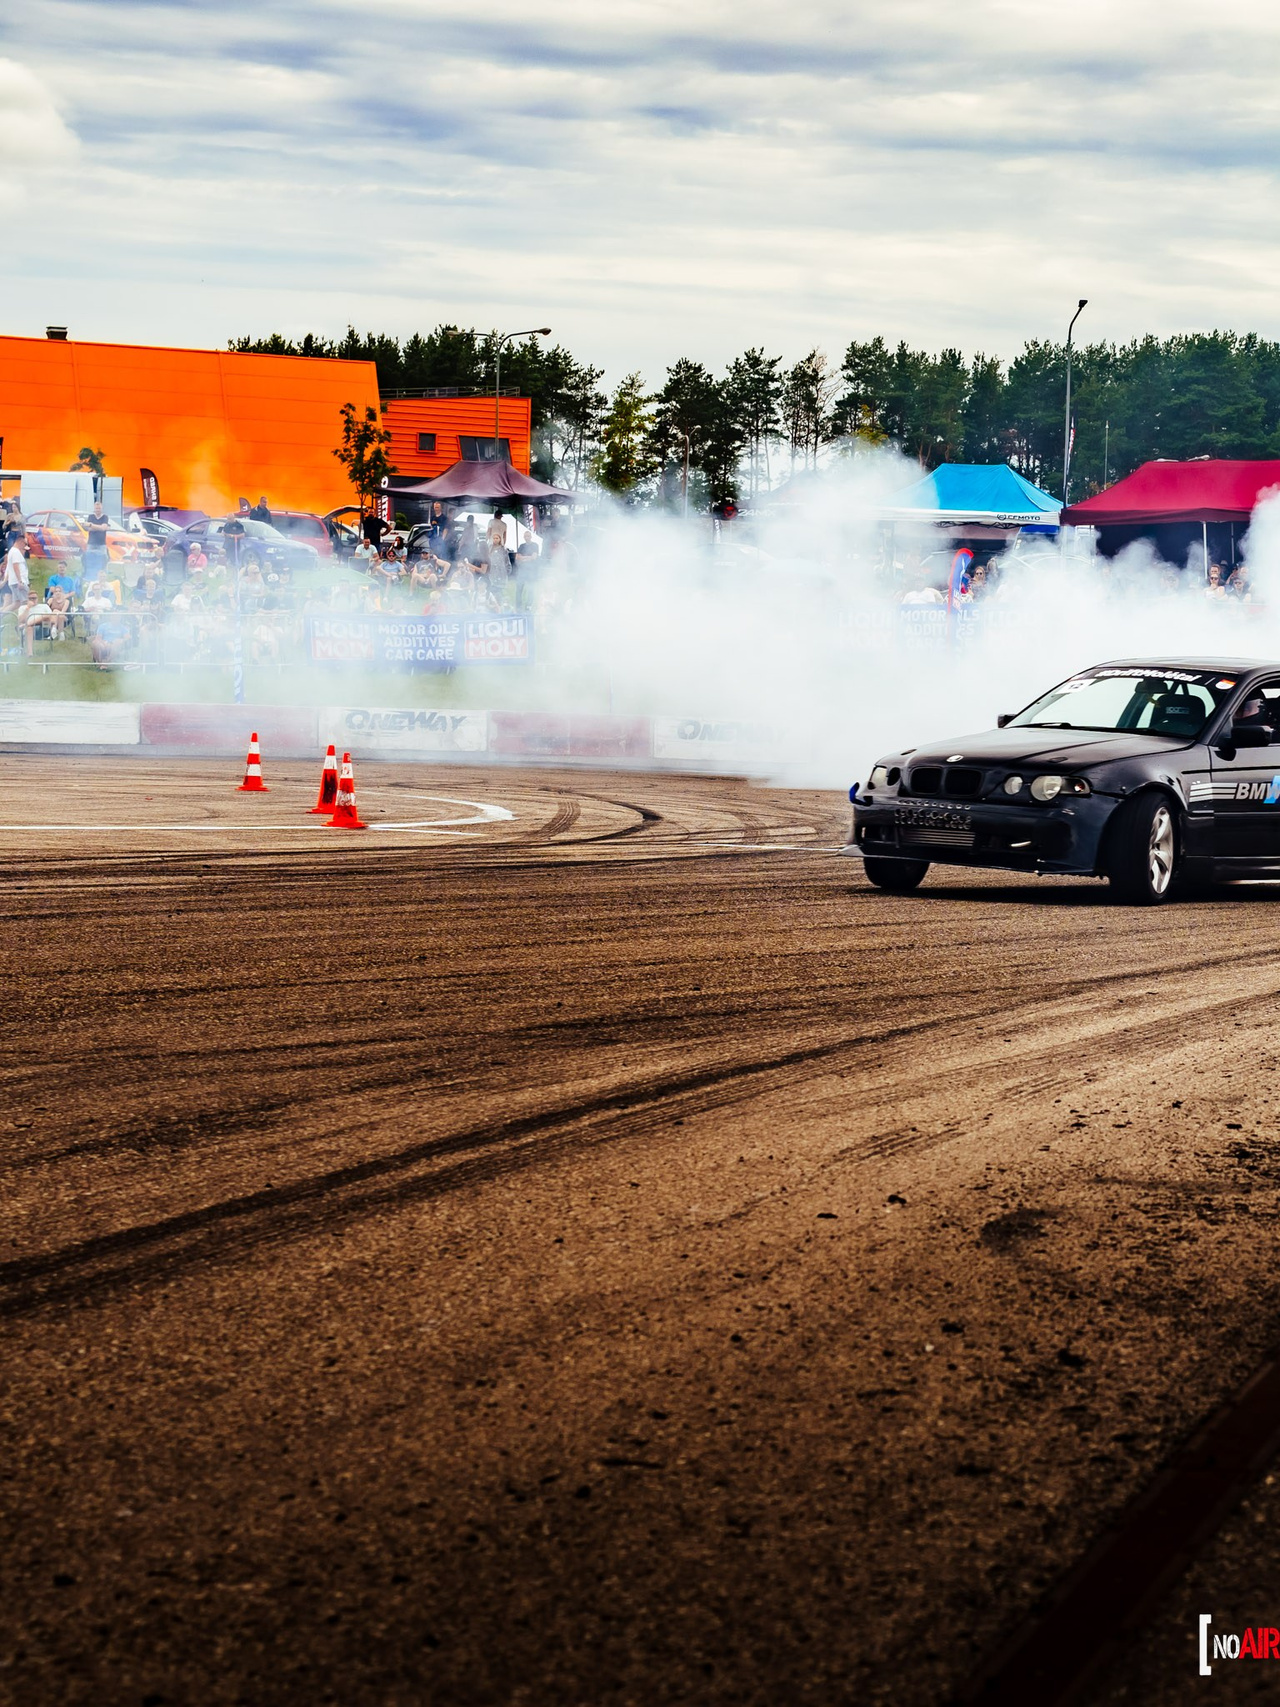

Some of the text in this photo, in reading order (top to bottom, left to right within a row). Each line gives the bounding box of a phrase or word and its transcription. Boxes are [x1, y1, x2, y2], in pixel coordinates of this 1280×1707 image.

[900, 609, 946, 622] MOTOR
[314, 620, 370, 639] LIQUI
[378, 623, 460, 635] MOTOR OILS
[468, 619, 524, 638] LIQUI
[384, 635, 456, 648] ADDITIVES
[466, 638, 526, 657] MOLY
[385, 648, 454, 661] CAR CARE
